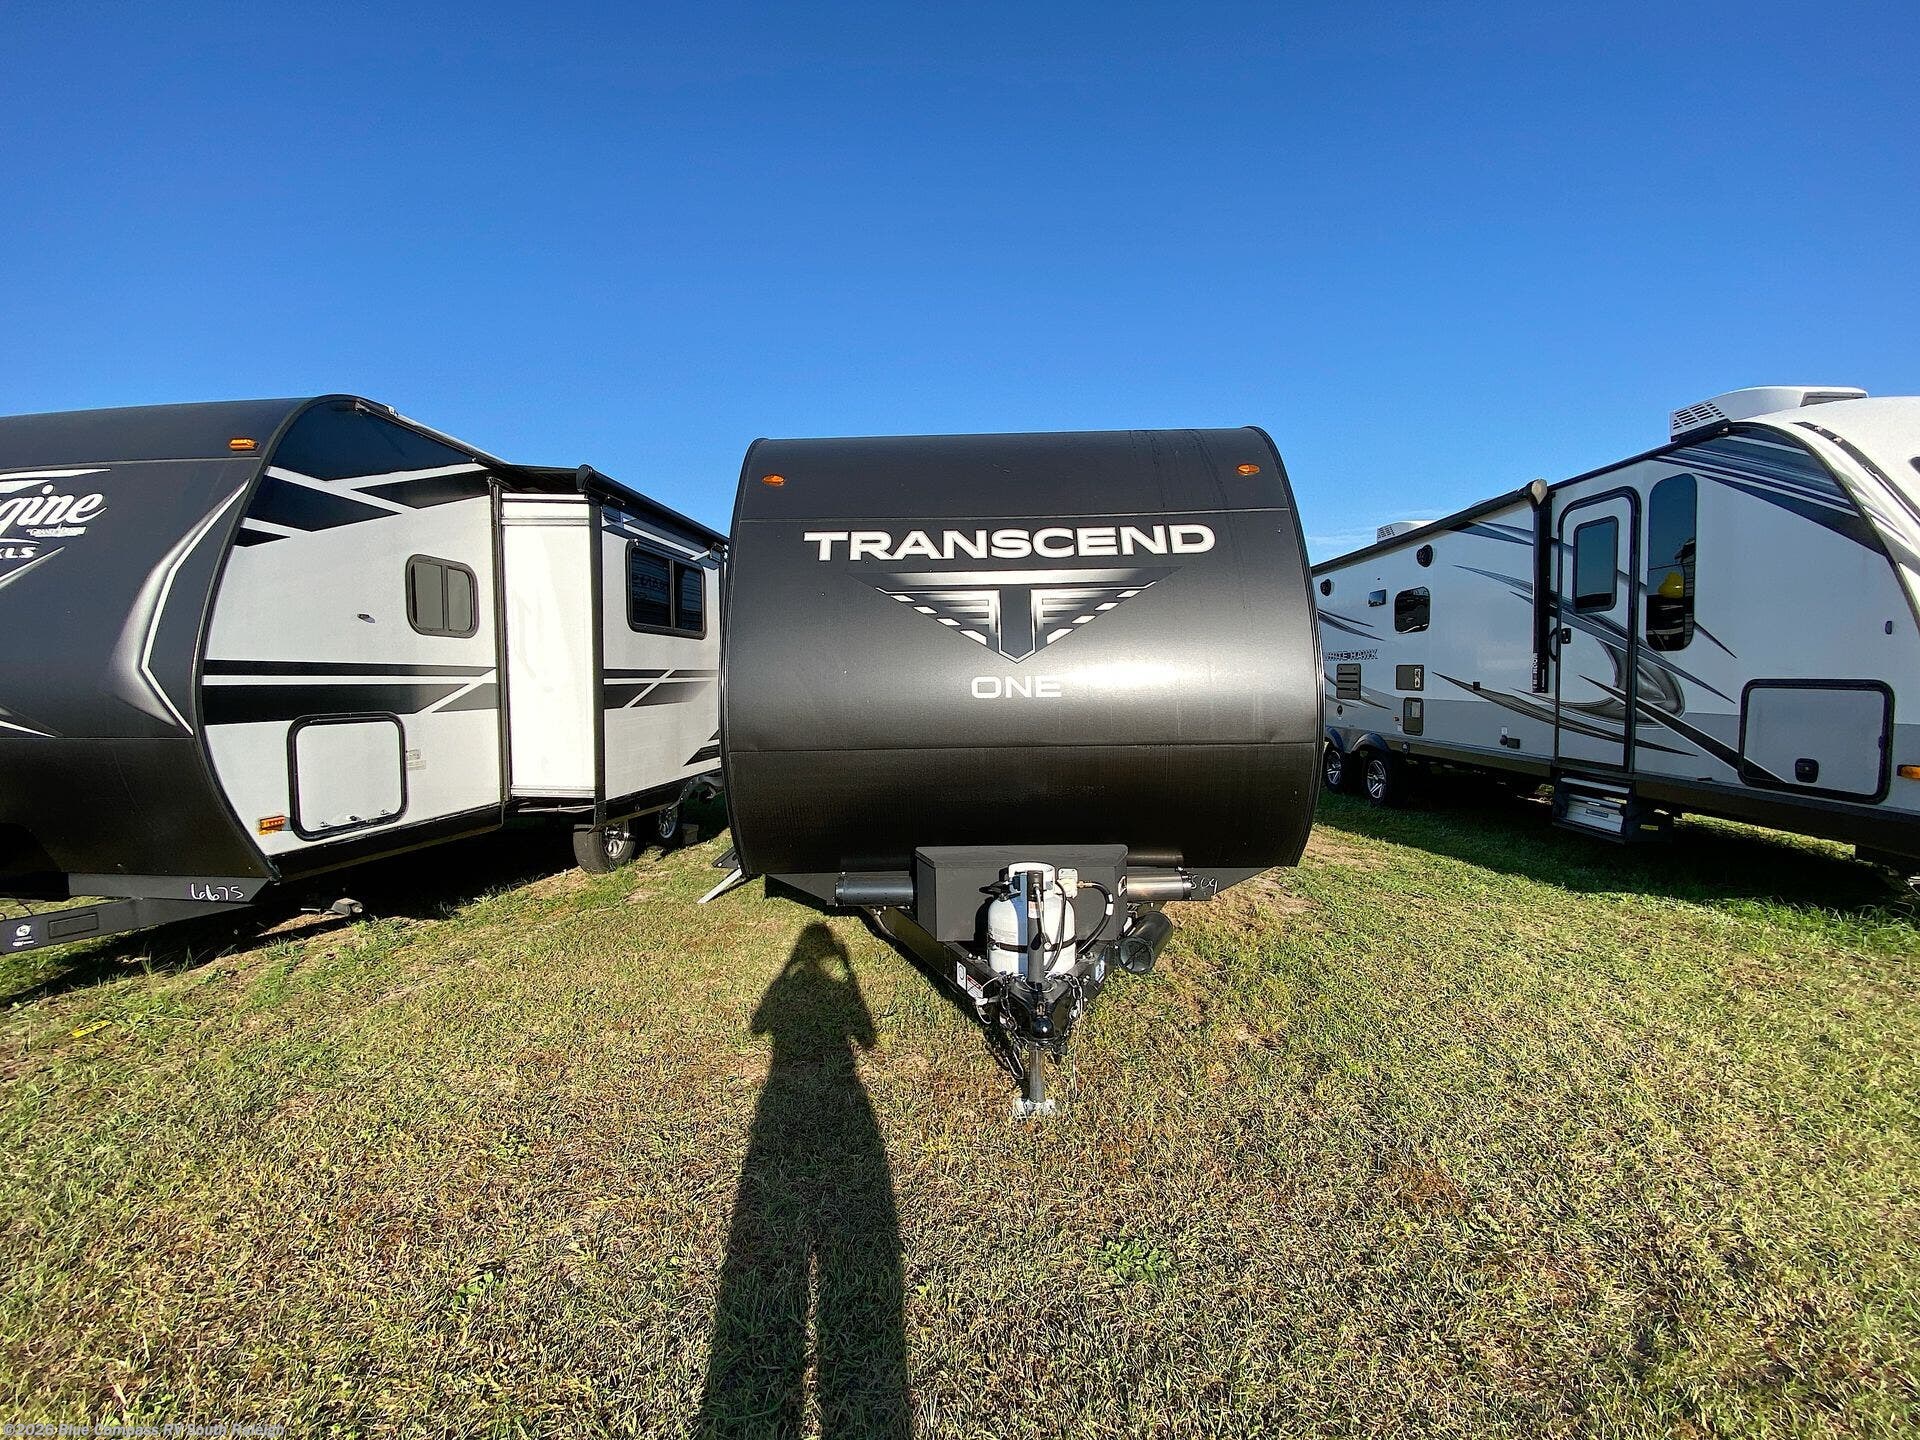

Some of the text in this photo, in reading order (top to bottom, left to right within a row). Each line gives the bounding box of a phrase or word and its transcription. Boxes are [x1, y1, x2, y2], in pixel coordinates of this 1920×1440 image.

[803, 523, 1217, 561] TRANSCEND
[1351, 648, 1379, 660] HAWK
[971, 675, 1062, 699] ONE
[190, 883, 244, 901] 6675
